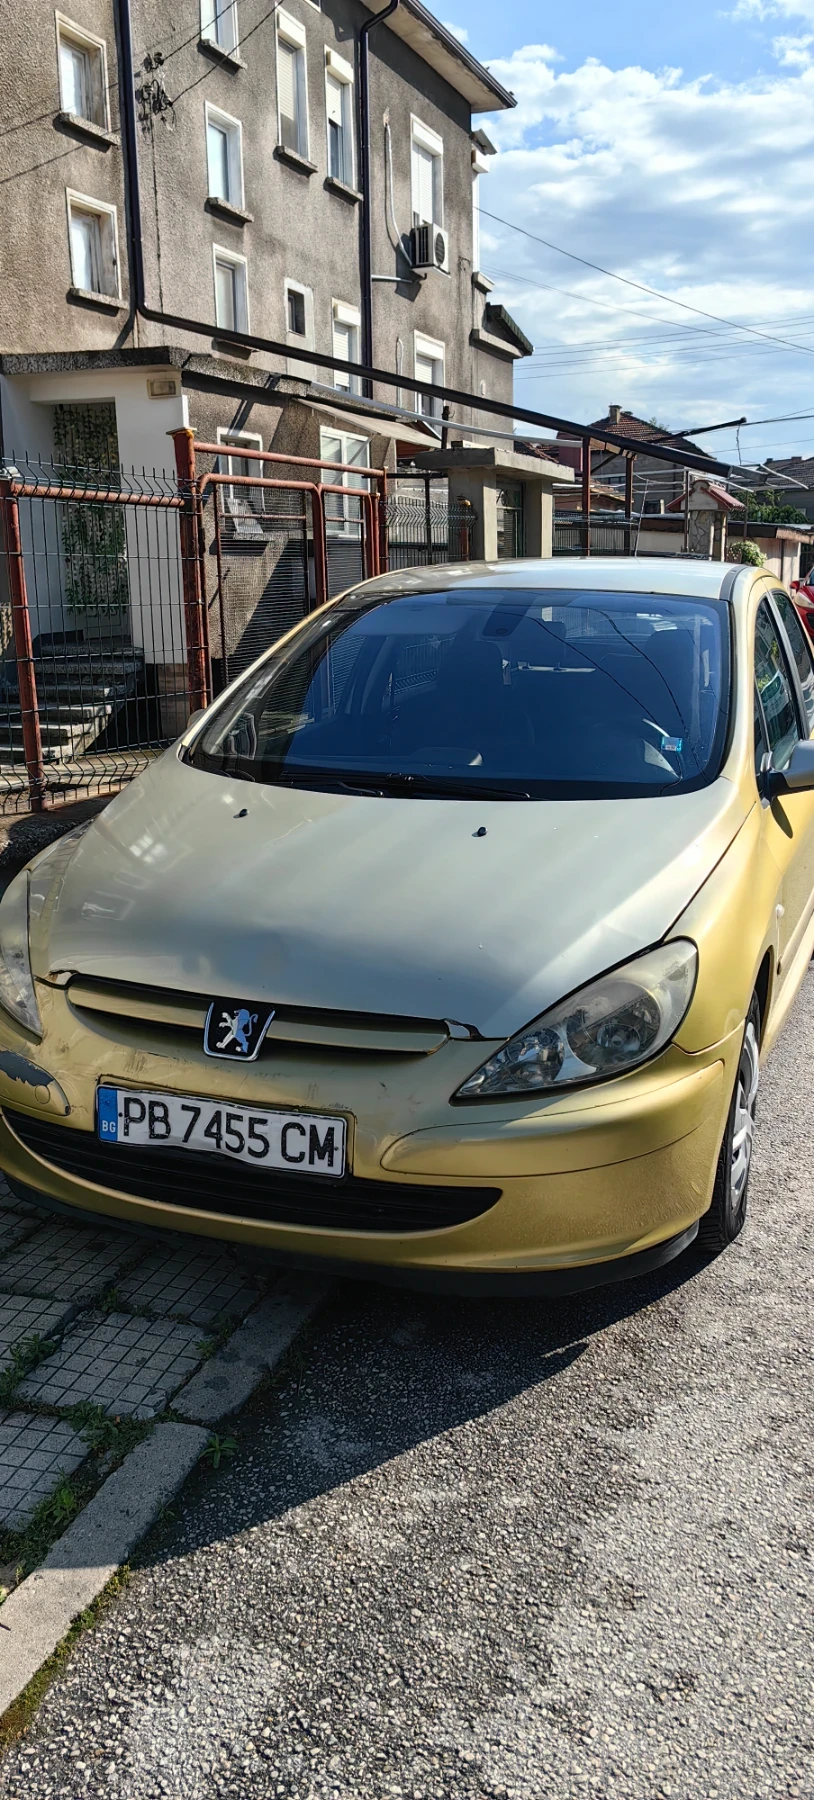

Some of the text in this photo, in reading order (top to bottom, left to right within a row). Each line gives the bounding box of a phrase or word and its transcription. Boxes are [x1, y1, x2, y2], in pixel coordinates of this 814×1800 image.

[101, 1120, 116, 1133] BG
[123, 1097, 335, 1167] PB 7455 CM
